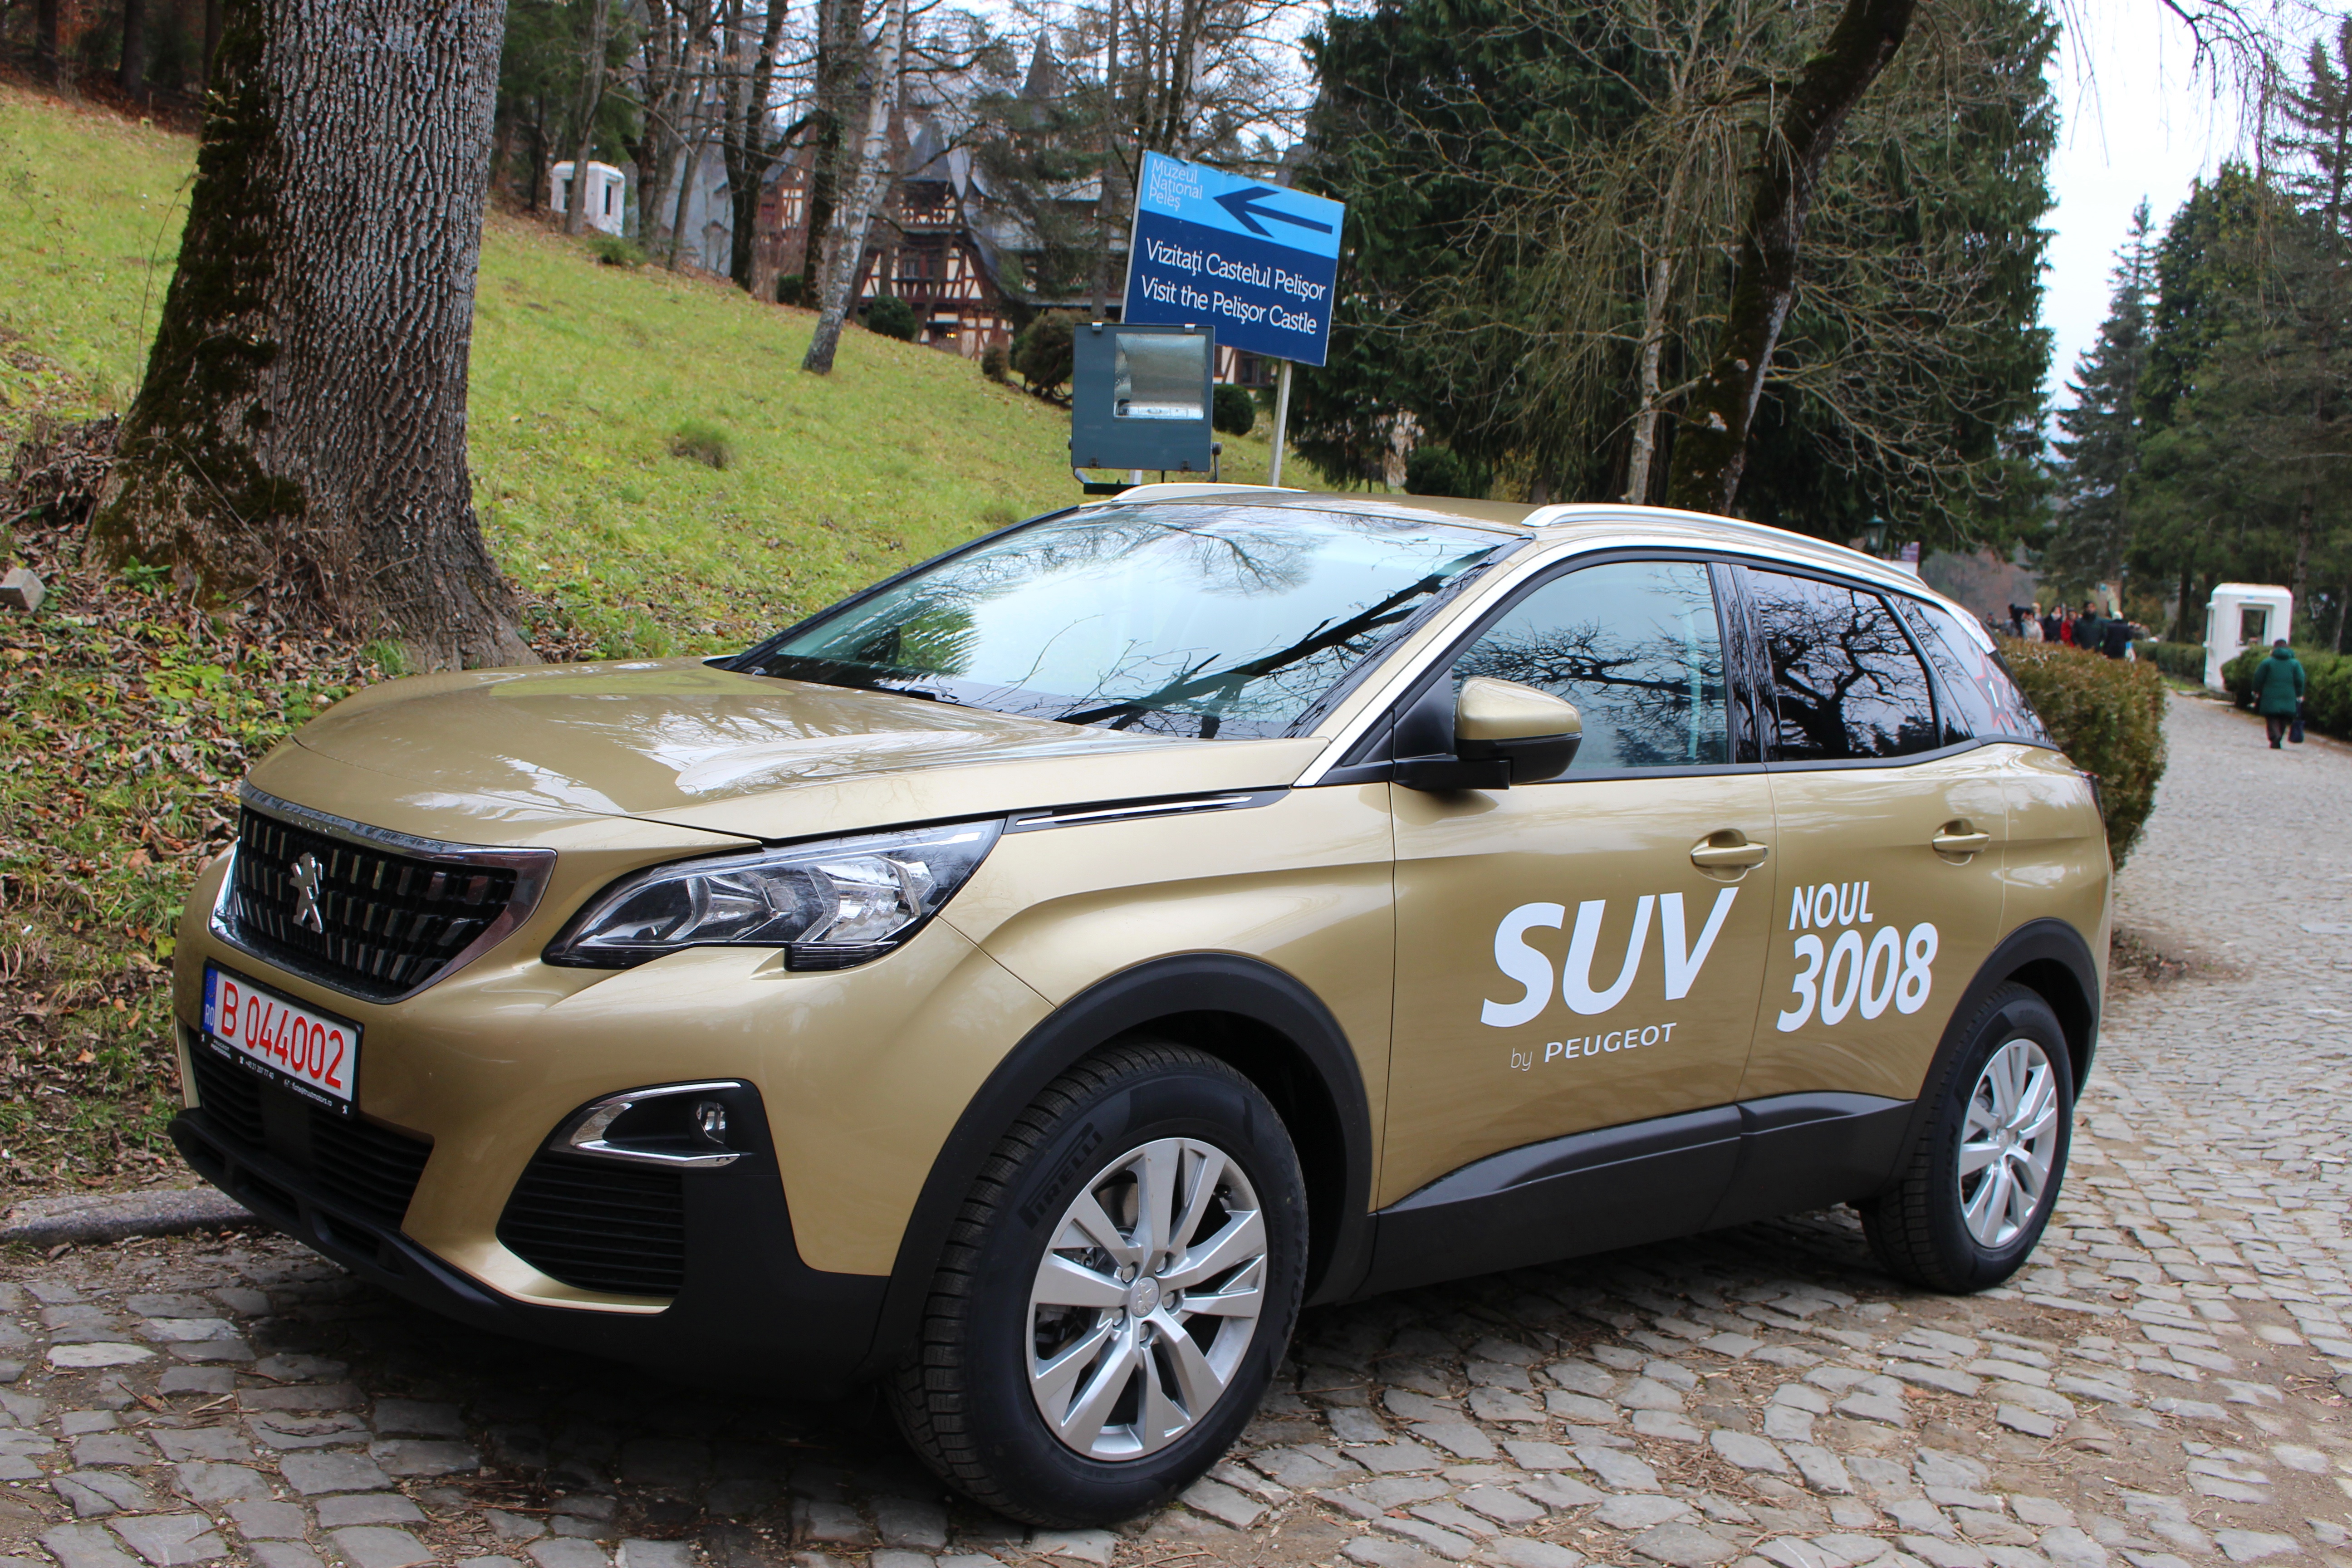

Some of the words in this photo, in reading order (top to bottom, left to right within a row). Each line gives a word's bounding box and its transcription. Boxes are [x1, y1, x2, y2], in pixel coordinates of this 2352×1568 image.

[1148, 186, 1181, 211] Peleş
[1152, 158, 1198, 184] Muzeul
[1146, 237, 1203, 276] Vizitaţi
[1206, 253, 1271, 289] Castelul
[1274, 269, 1326, 303] Pelişor
[1141, 274, 1177, 304] Visit
[1181, 284, 1208, 310] the
[1212, 290, 1267, 325] Pelişor
[1269, 304, 1317, 335] Castle
[1988, 681, 1999, 708] 1
[1788, 881, 1874, 931] NOUL
[1480, 886, 1740, 1028] SUV
[1776, 922, 1938, 1032] 3008
[205, 1003, 215, 1027] RO
[221, 980, 239, 1037] B
[245, 995, 344, 1090] 044002
[1510, 1047, 1533, 1071] by
[1543, 1022, 1677, 1063] PEUGEOT
[1017, 1122, 1104, 1231] PIRELLI
